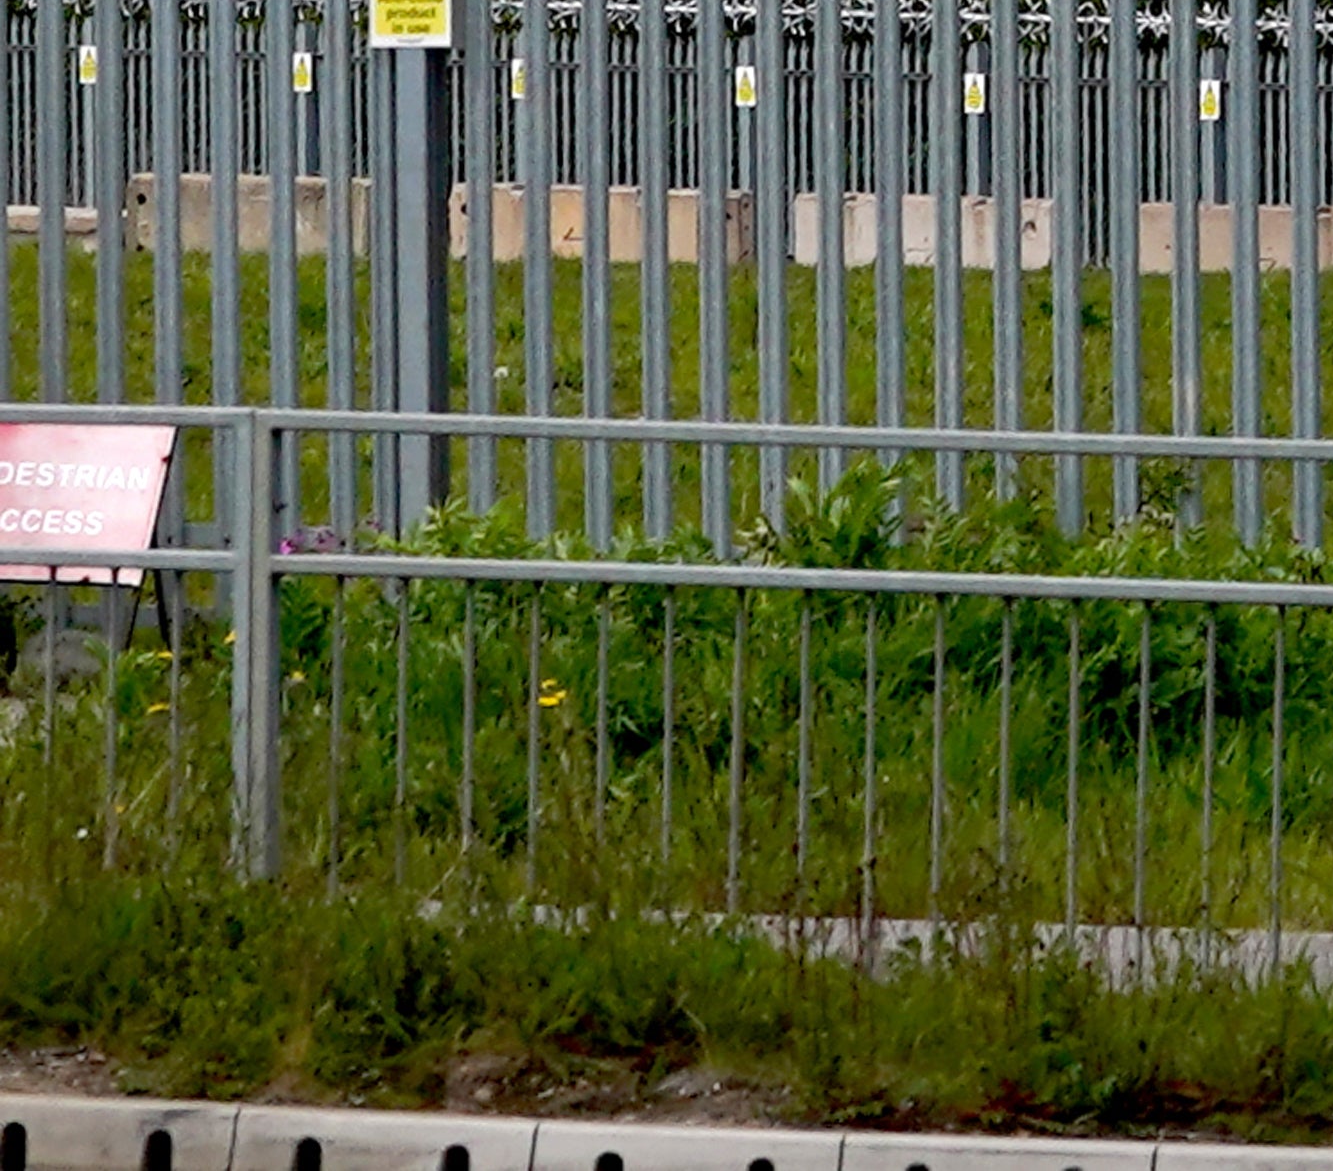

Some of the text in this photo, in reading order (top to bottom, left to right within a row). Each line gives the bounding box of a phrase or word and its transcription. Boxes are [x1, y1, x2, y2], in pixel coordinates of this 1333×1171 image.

[385, 8, 436, 22] product
[0, 461, 150, 490] DESTRIAN
[0, 508, 104, 535] CCESS
